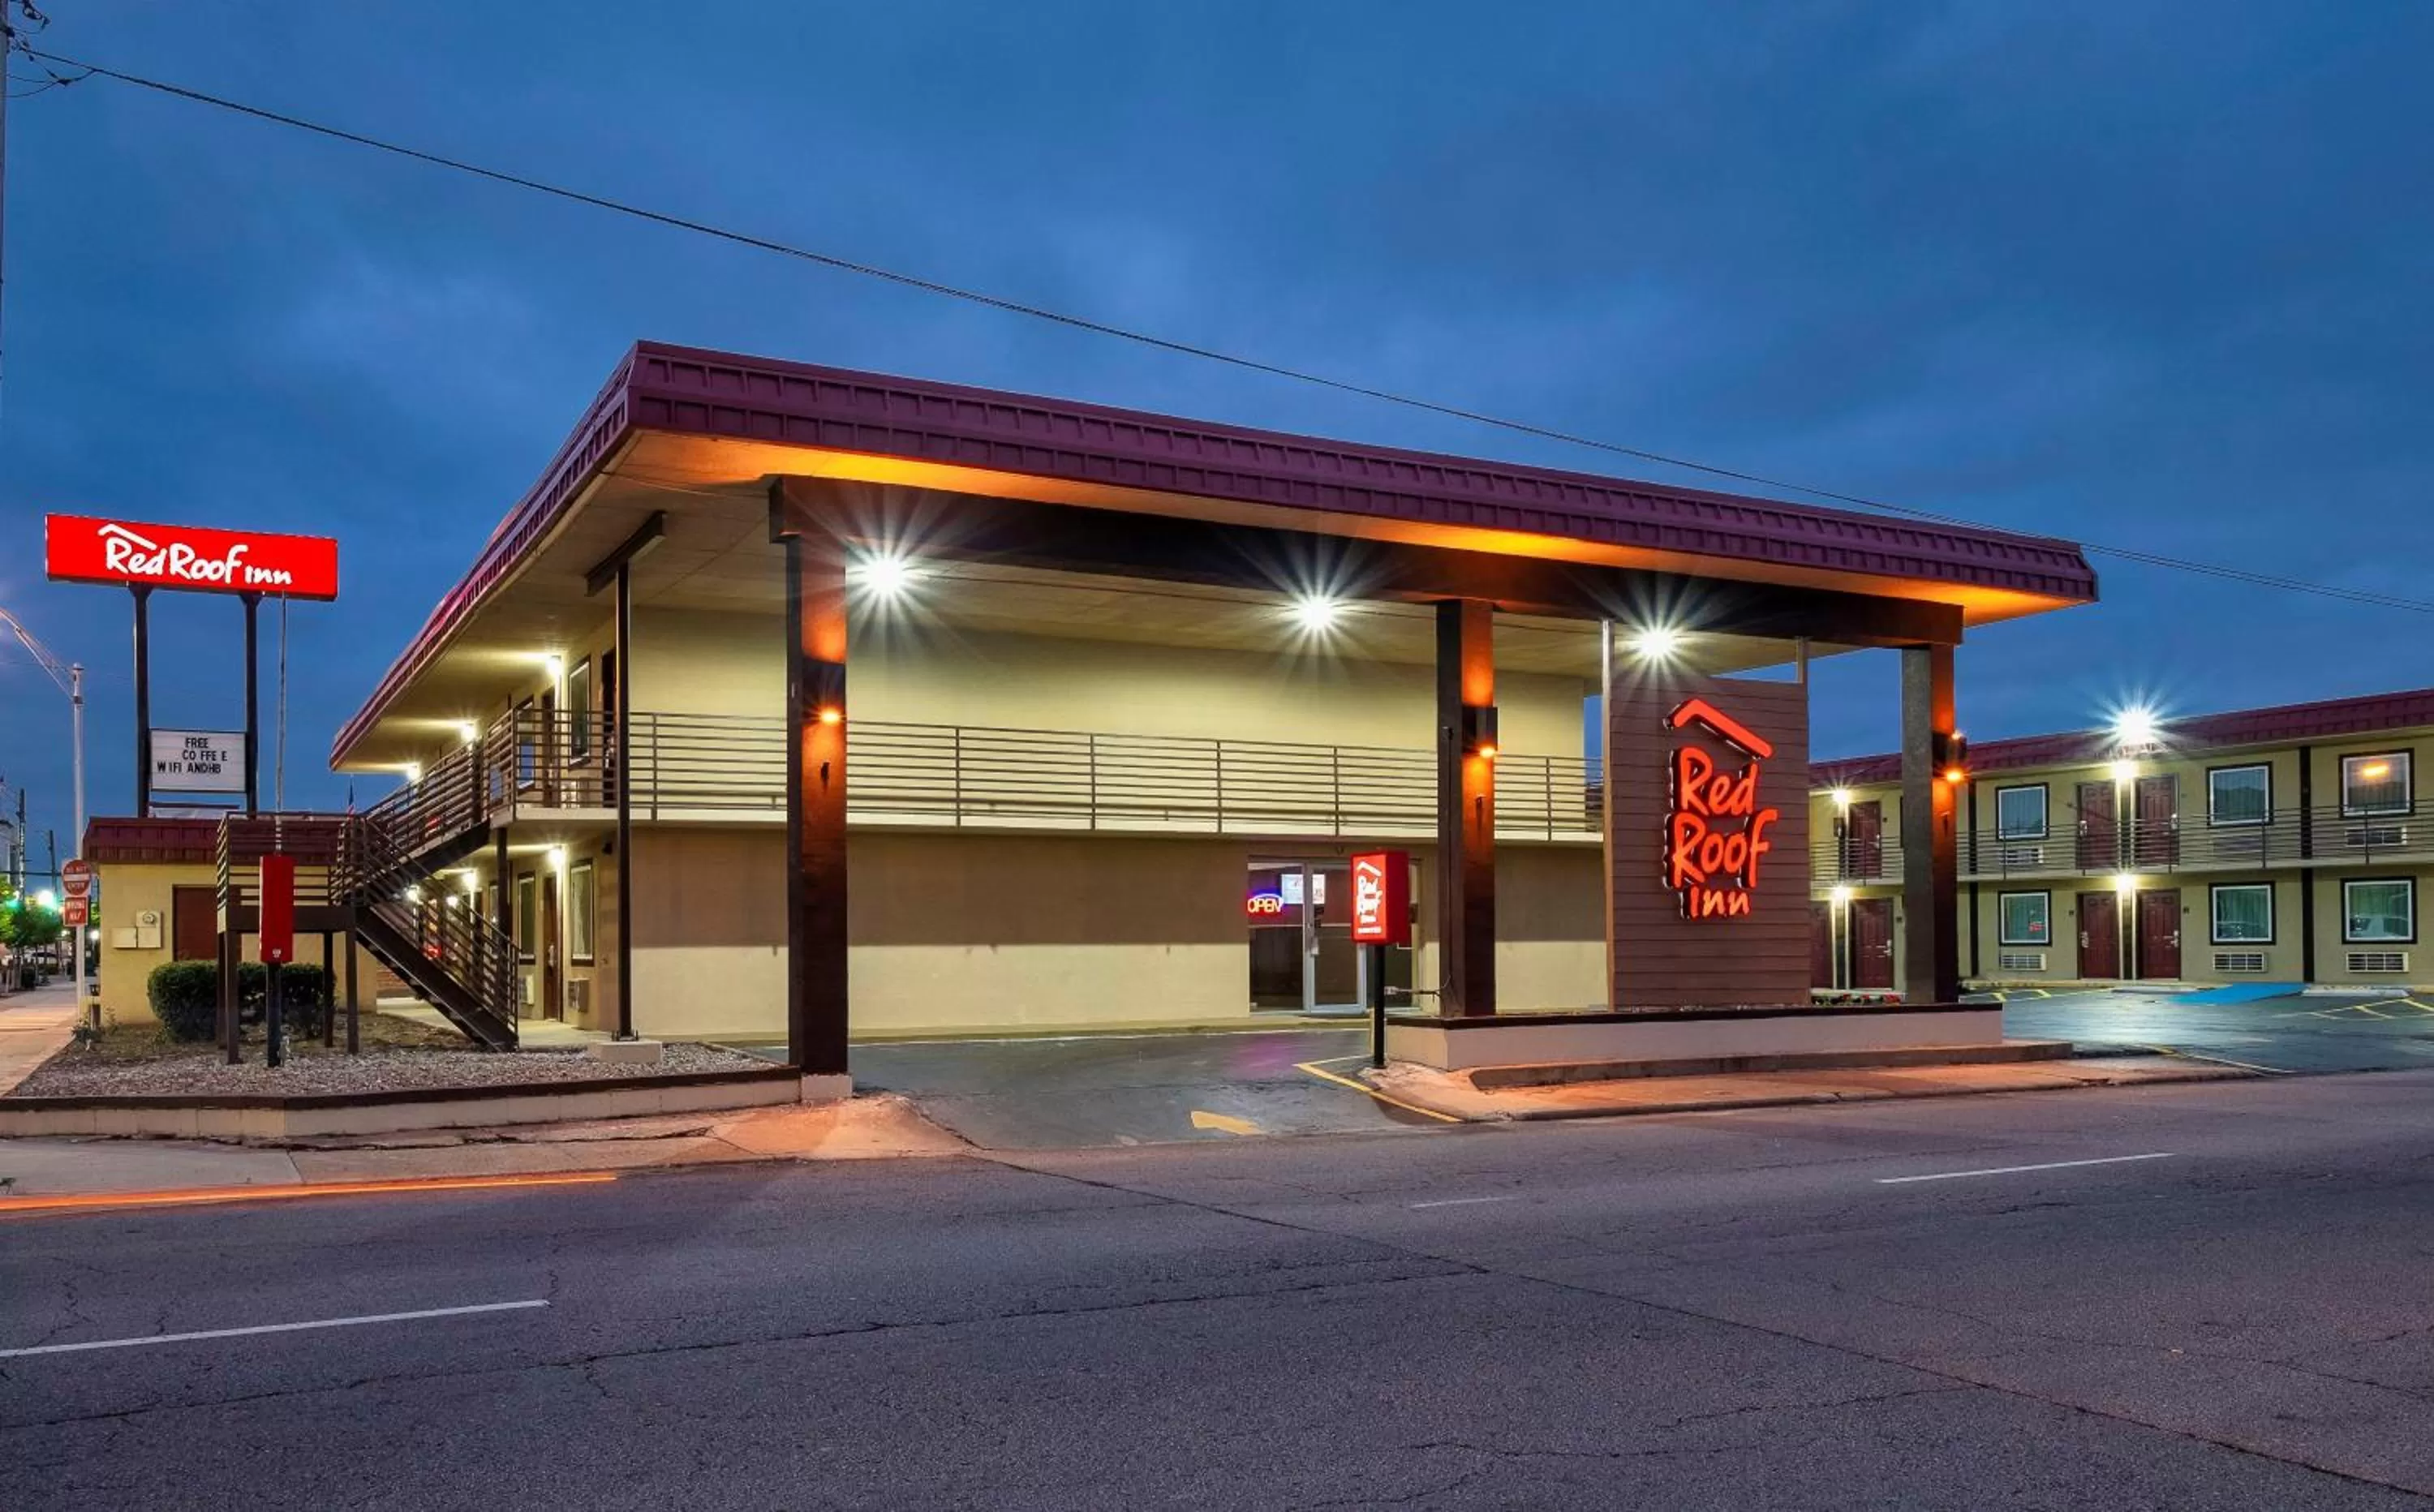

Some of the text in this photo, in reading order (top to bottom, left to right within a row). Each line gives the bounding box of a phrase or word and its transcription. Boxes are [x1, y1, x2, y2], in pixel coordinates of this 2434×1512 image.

[105, 537, 167, 574] Red
[169, 543, 248, 583] Roof
[185, 737, 209, 749] FREE
[1678, 745, 1760, 817] Red
[1671, 809, 1779, 889] Roof
[1247, 898, 1283, 913] OPEN
